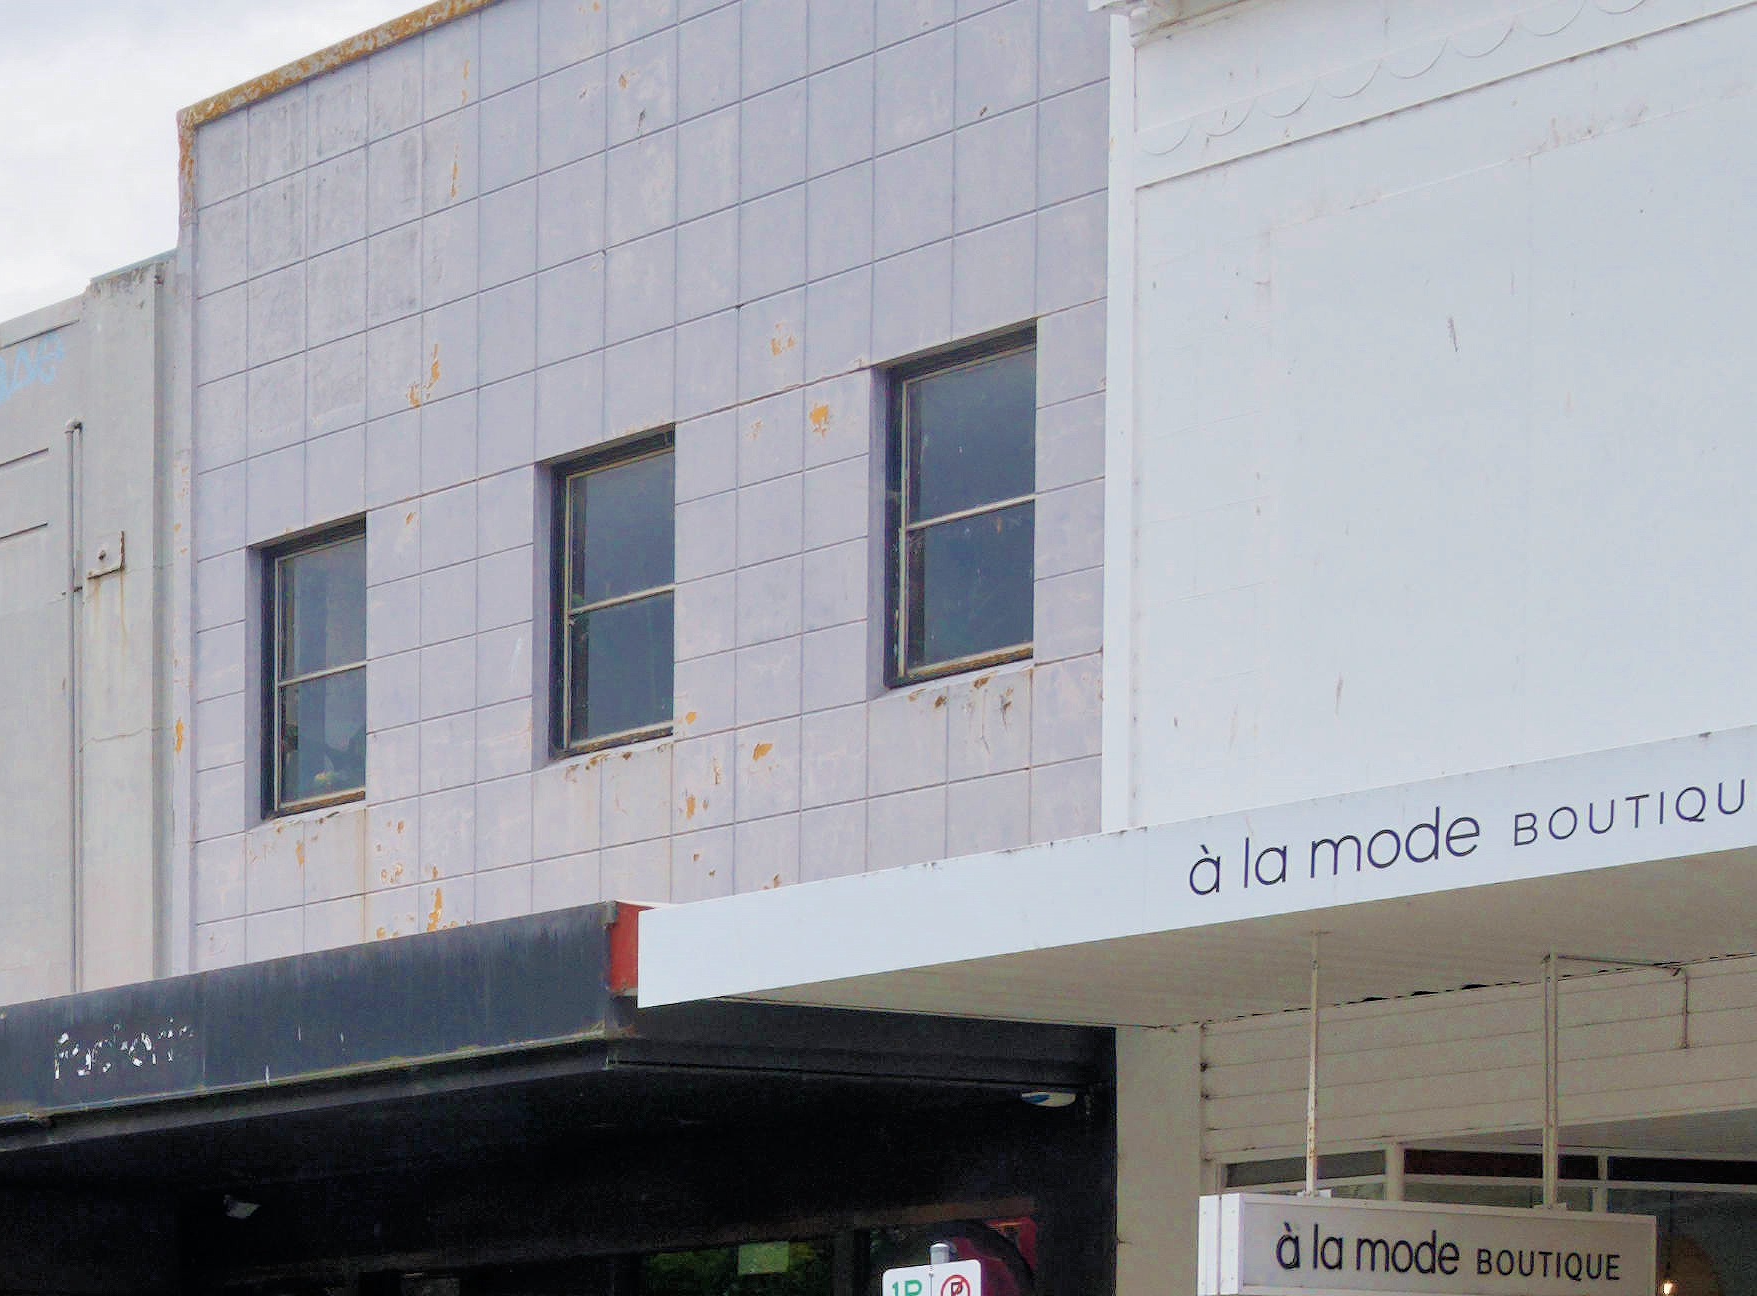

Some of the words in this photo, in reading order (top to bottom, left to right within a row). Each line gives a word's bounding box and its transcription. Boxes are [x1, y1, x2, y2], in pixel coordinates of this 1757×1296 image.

[1189, 844, 1221, 896] à
[1242, 837, 1288, 889] la
[1310, 806, 1481, 879] mode
[1513, 778, 1746, 847] BOUTIQU
[1276, 1222, 1300, 1270] à
[1313, 1223, 1343, 1270] la
[1356, 1230, 1460, 1275] mode
[1476, 1248, 1621, 1282] BOUTIQUE
